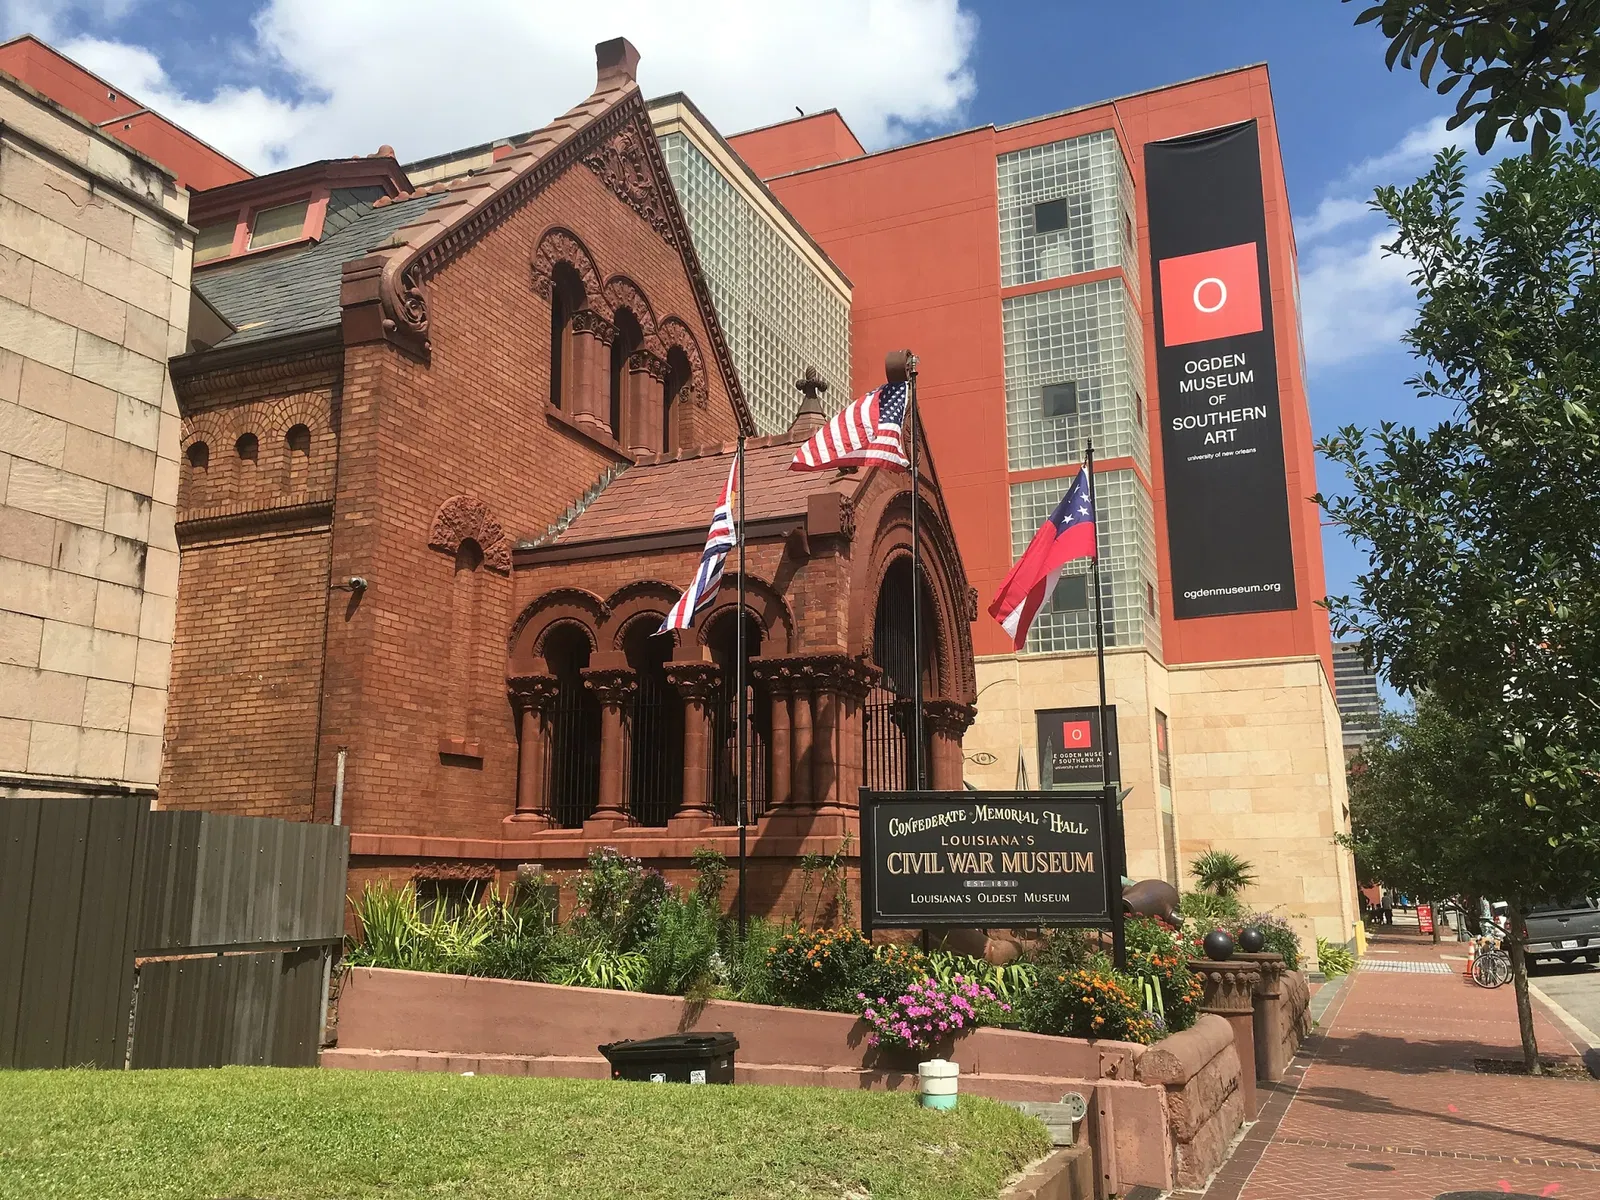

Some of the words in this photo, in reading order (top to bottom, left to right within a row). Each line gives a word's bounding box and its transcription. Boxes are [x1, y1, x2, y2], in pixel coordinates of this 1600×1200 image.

[1193, 277, 1227, 313] O
[1184, 353, 1246, 374] OGDEN
[1179, 369, 1254, 393] MUSEUM
[1208, 394, 1227, 406] OF
[1172, 405, 1267, 431] SOUTHERN
[1203, 428, 1237, 445] ART
[1187, 452, 1214, 462] university
[1183, 583, 1281, 600] ogdenmuseum.org
[1072, 729, 1082, 740] O
[889, 809, 967, 836] CONFEDERATE
[971, 804, 1039, 825] MEMORIAL
[1042, 810, 1089, 835] HALL
[941, 835, 1036, 847] LOUISIANA'S
[886, 851, 945, 875] CIVIL
[946, 851, 996, 874] WAR
[1001, 851, 1095, 874] MUSEUM
[910, 893, 972, 904] LOUISIANA'S
[977, 893, 1018, 903] OLDEST
[1024, 892, 1070, 903] MUSEUM
